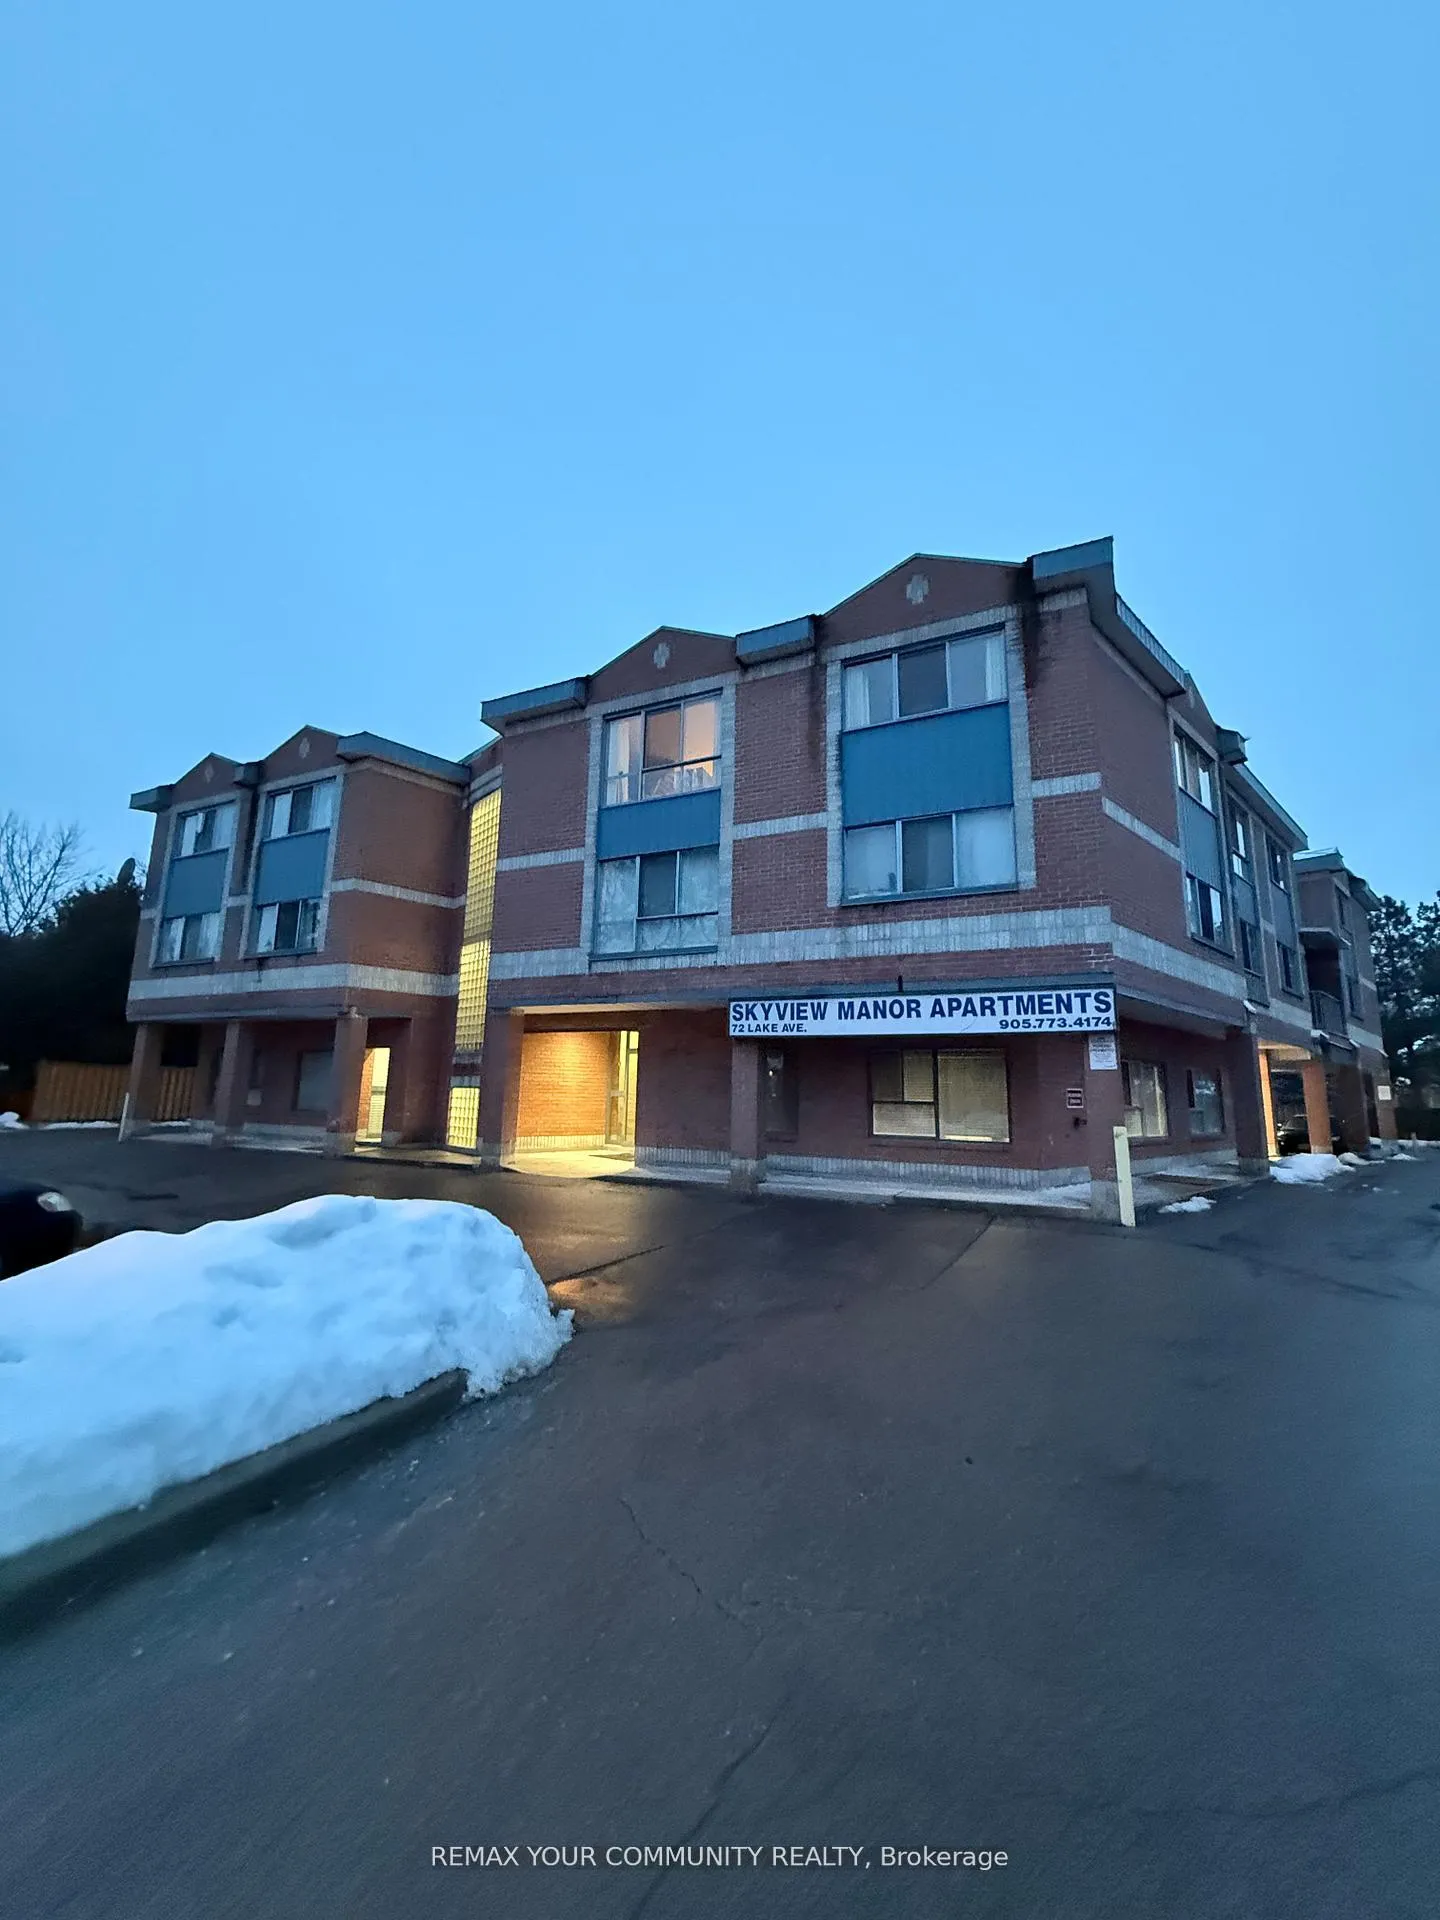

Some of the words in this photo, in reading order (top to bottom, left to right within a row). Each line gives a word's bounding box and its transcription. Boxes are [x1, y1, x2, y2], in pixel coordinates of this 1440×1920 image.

[731, 1001, 829, 1022] SKYVIEW
[837, 998, 922, 1020] MANOR
[930, 991, 1112, 1018] APARTMENTS
[731, 1023, 745, 1033] 72
[747, 1023, 779, 1033] LAKE
[782, 1023, 807, 1033] AVE.
[999, 1016, 1112, 1030] 905.773.4174
